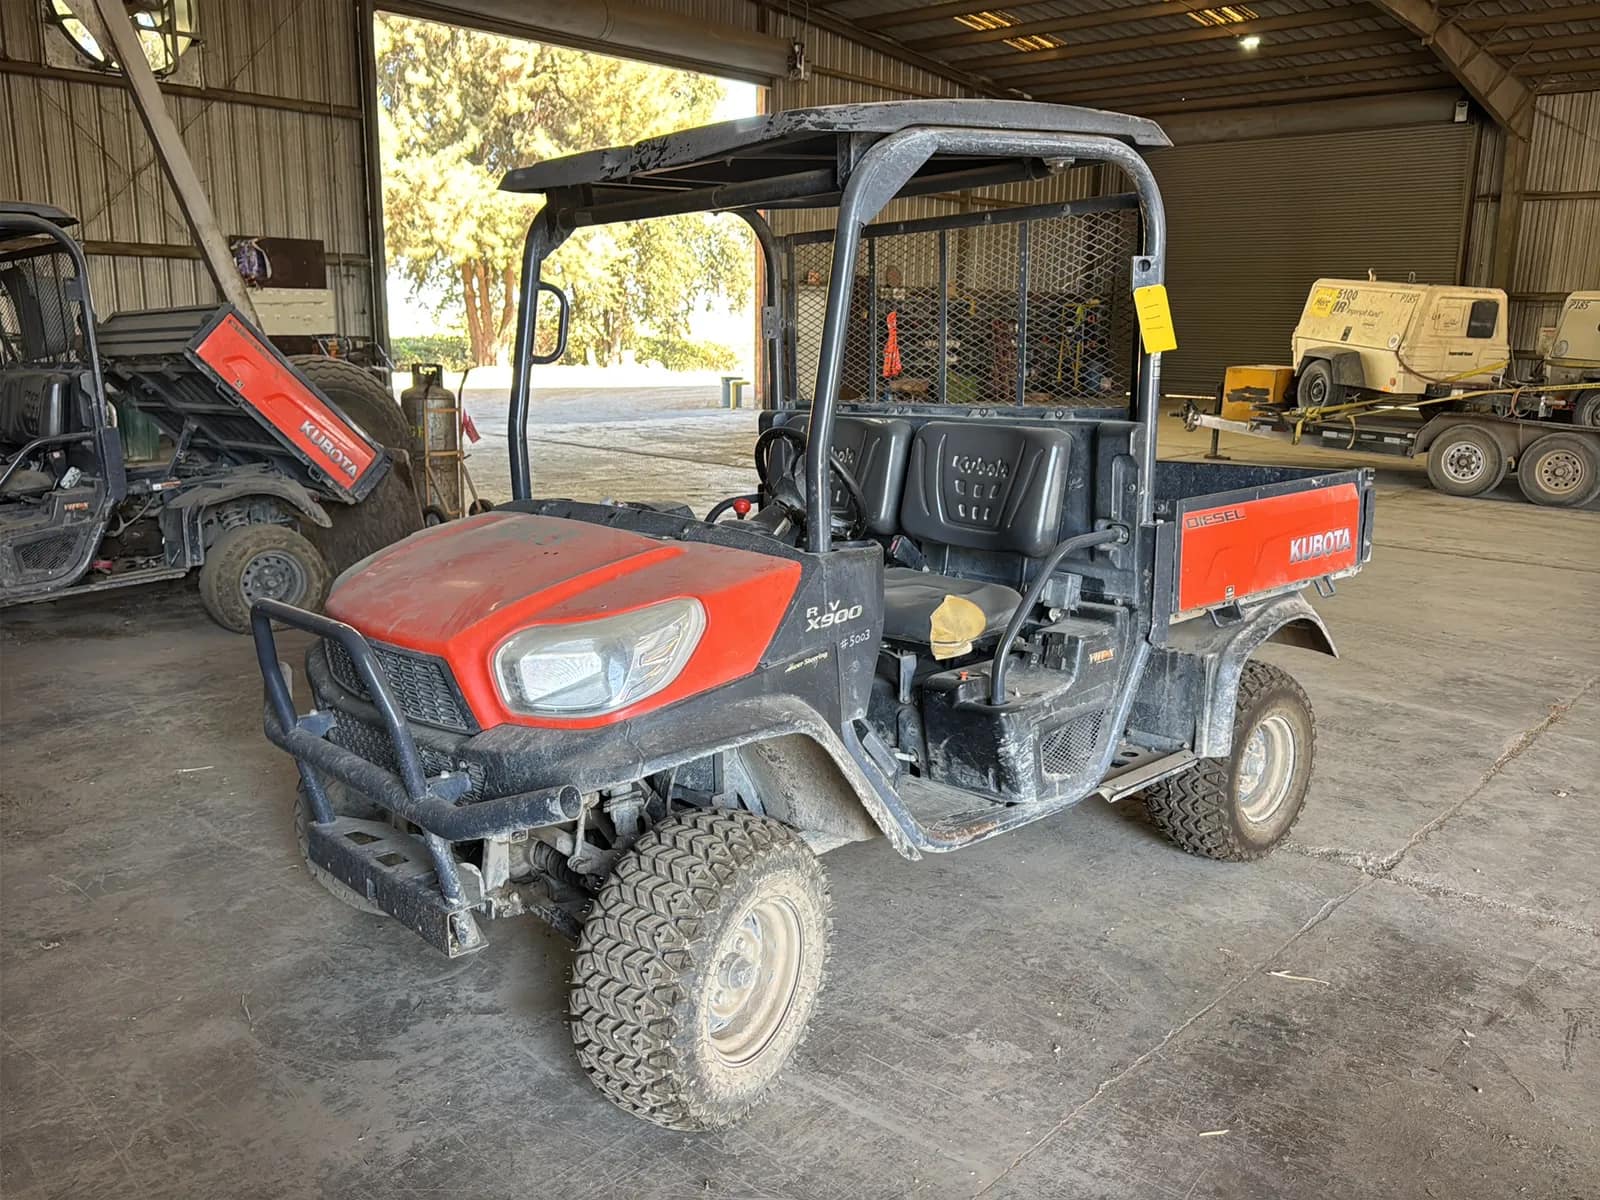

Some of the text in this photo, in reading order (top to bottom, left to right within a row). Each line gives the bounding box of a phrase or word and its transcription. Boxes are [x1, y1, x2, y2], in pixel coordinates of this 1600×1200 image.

[1336, 288, 1359, 300] 5100
[300, 420, 358, 478] KUBOTA
[1186, 510, 1247, 529] DIESEL
[1290, 528, 1352, 563] KUBOTA
[805, 605, 863, 632] X900
[840, 629, 871, 649] #5003
